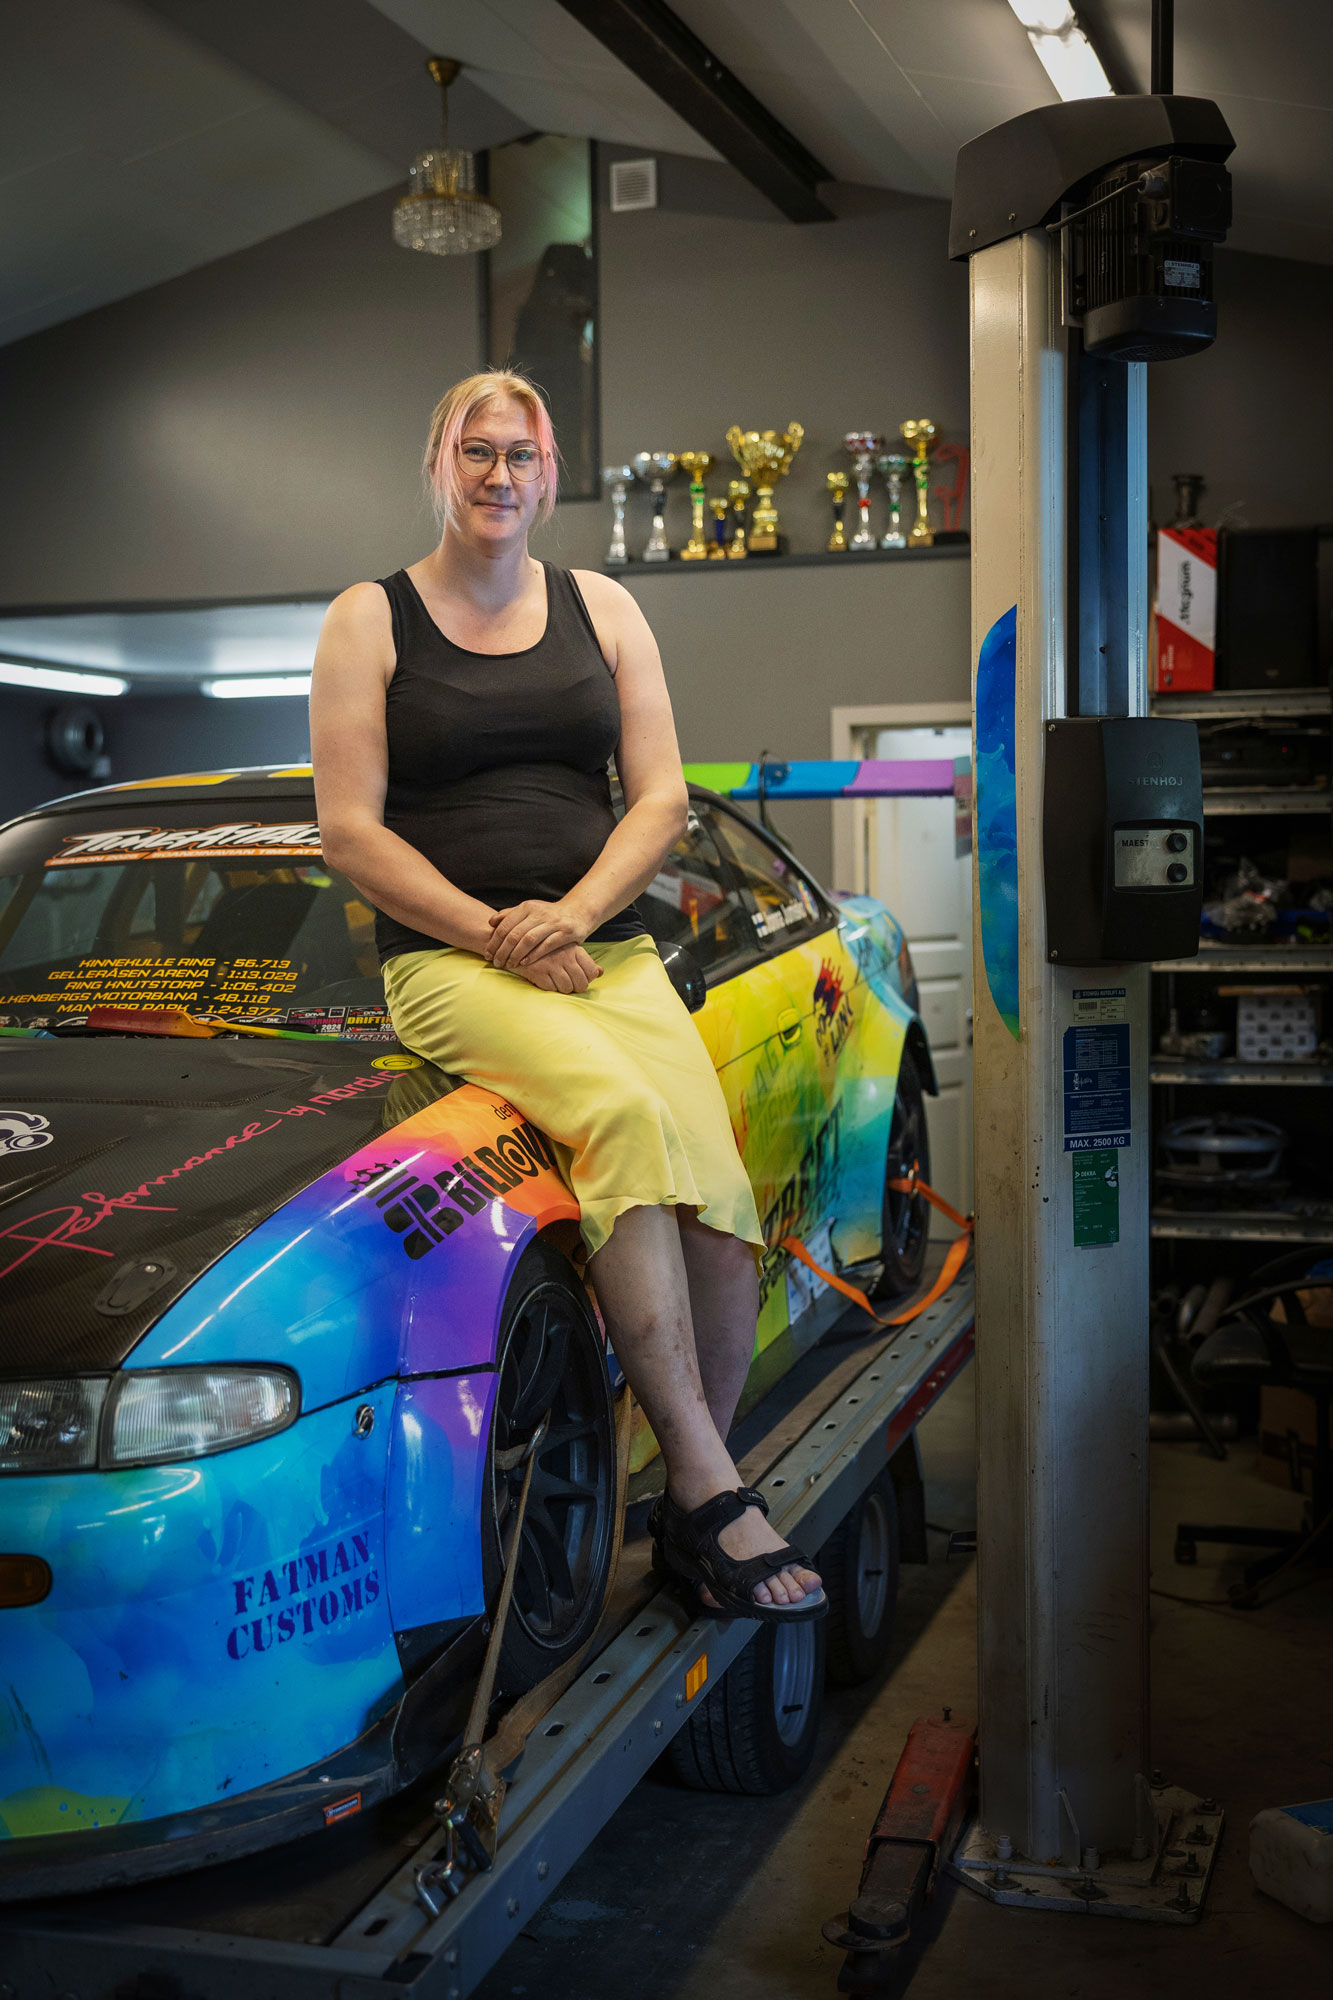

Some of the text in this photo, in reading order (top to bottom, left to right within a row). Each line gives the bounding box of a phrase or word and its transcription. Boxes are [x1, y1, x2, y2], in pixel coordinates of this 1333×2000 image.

[259, 848, 291, 856] TIME
[79, 958, 176, 968] KINNEKULLE
[177, 958, 216, 967] RING
[233, 959, 291, 969] 56.713
[48, 968, 151, 980] GELLERÅSEN
[152, 969, 209, 978] ARENA
[227, 970, 298, 981] 1:13.028
[64, 981, 103, 990] RING
[104, 980, 204, 990] KNUTSTORP
[220, 982, 297, 993] 1:06.402
[0, 992, 91, 1004] LKENBERGS
[92, 991, 198, 1001] MOTORBANA
[213, 993, 271, 1004] 48.118
[347, 1016, 392, 1024] DRIFTIN
[1069, 1136, 1125, 1149] MAX. 2500 KG
[233, 1531, 369, 1615] FATMAN
[227, 1569, 380, 1660] CUSTOMS
